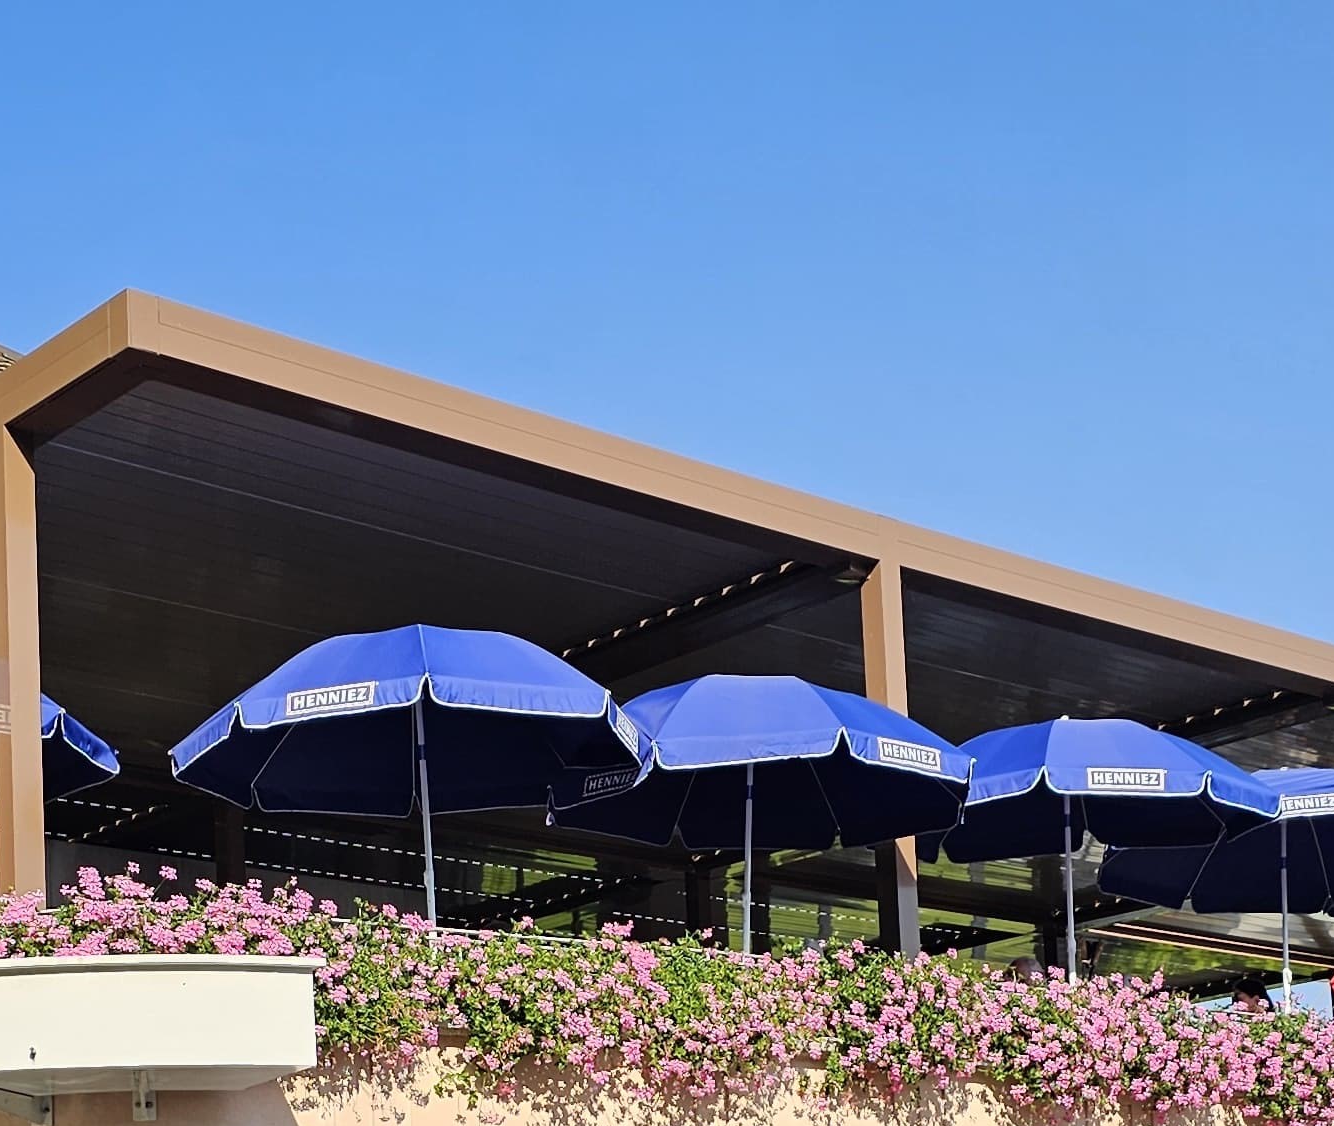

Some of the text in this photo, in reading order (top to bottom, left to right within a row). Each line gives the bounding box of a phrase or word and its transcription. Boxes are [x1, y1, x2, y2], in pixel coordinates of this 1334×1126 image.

[292, 686, 369, 710] HENNIEZ
[883, 742, 937, 766] HENNIEZ
[1092, 771, 1160, 786] HENNIEZ
